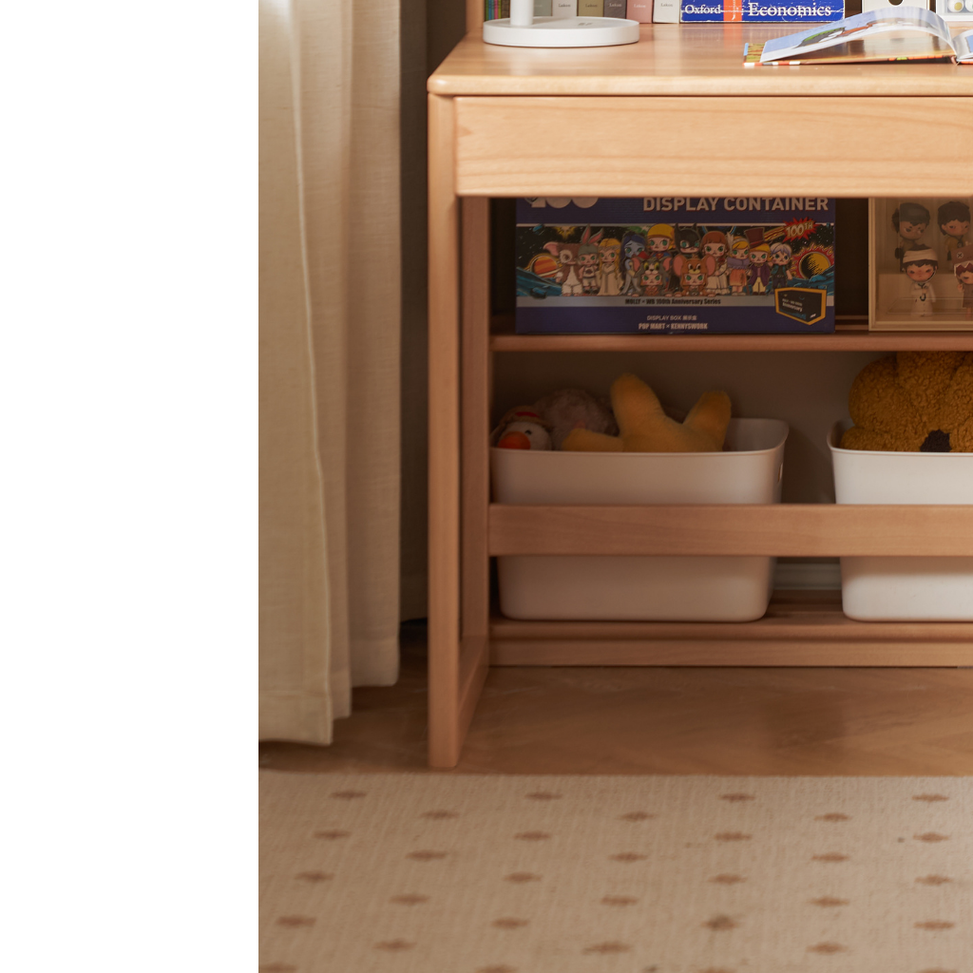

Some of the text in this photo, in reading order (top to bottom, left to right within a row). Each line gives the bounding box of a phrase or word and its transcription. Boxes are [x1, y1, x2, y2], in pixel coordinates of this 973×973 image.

[684, 3, 722, 15] Oxford
[748, 1, 832, 19] Economics
[643, 197, 829, 212] DISPLAY CONTAINER
[786, 222, 814, 237] 100TH
[671, 298, 703, 306] Anniversary
